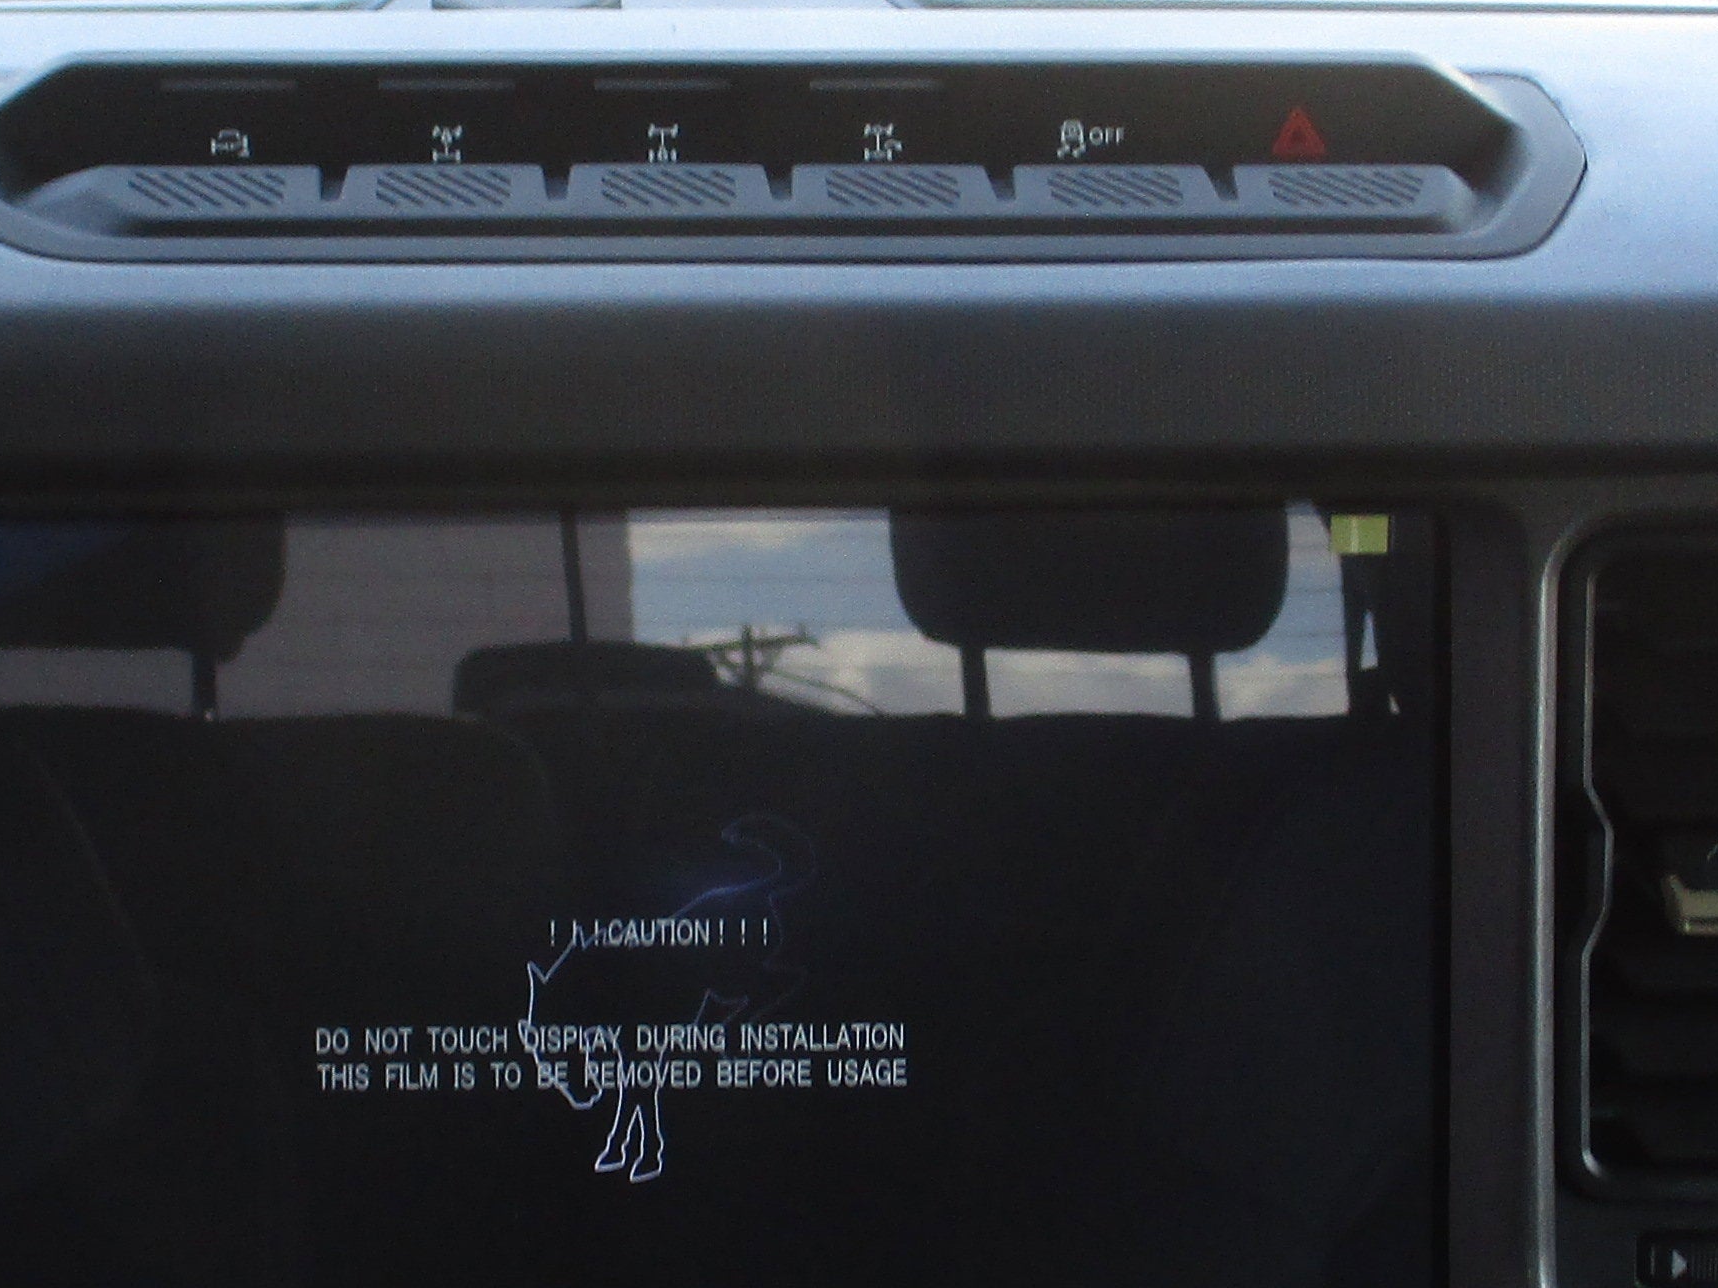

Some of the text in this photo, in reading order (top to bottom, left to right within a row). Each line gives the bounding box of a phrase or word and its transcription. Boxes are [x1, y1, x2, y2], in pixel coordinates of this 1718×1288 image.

[1088, 126, 1125, 146] OFF
[315, 1022, 905, 1055] DO NOT TOUCH DISPLAY DURING INSTALLATION
[317, 1057, 908, 1091] THIS FILM IS TO BE REMOVED BEFORE USAGE
